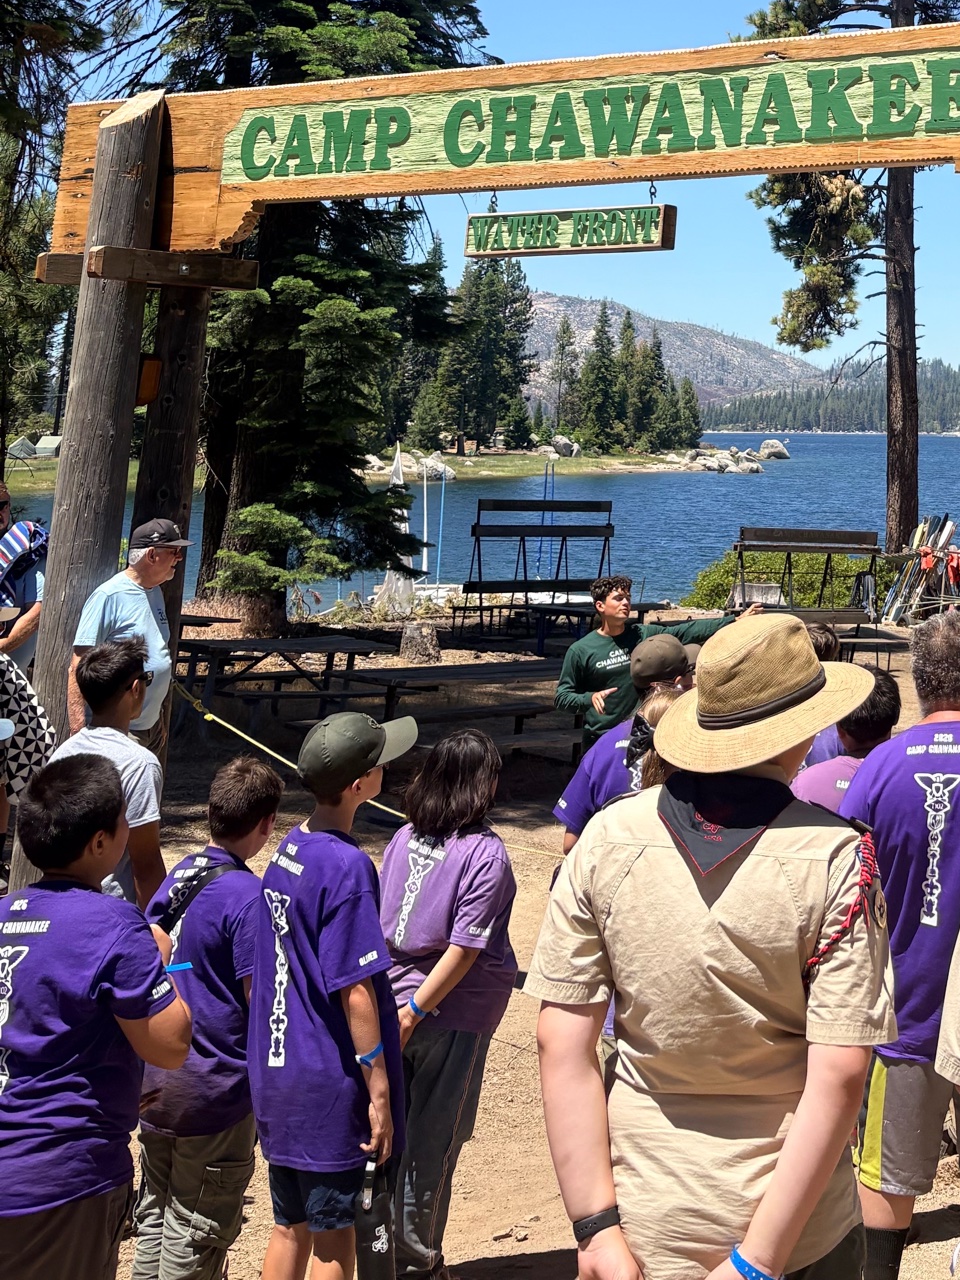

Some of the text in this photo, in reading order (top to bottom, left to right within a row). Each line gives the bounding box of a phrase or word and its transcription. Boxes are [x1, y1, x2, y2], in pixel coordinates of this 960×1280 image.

[240, 106, 411, 181] CAMP
[471, 207, 660, 252] WATER FRONT
[609, 648, 629, 658] CAMP
[595, 654, 631, 669] CHAWANA
[906, 745, 927, 755] CAMP
[277, 854, 305, 876] CHAWANAKEE
[2, 920, 51, 934] CHAWANAKEE
